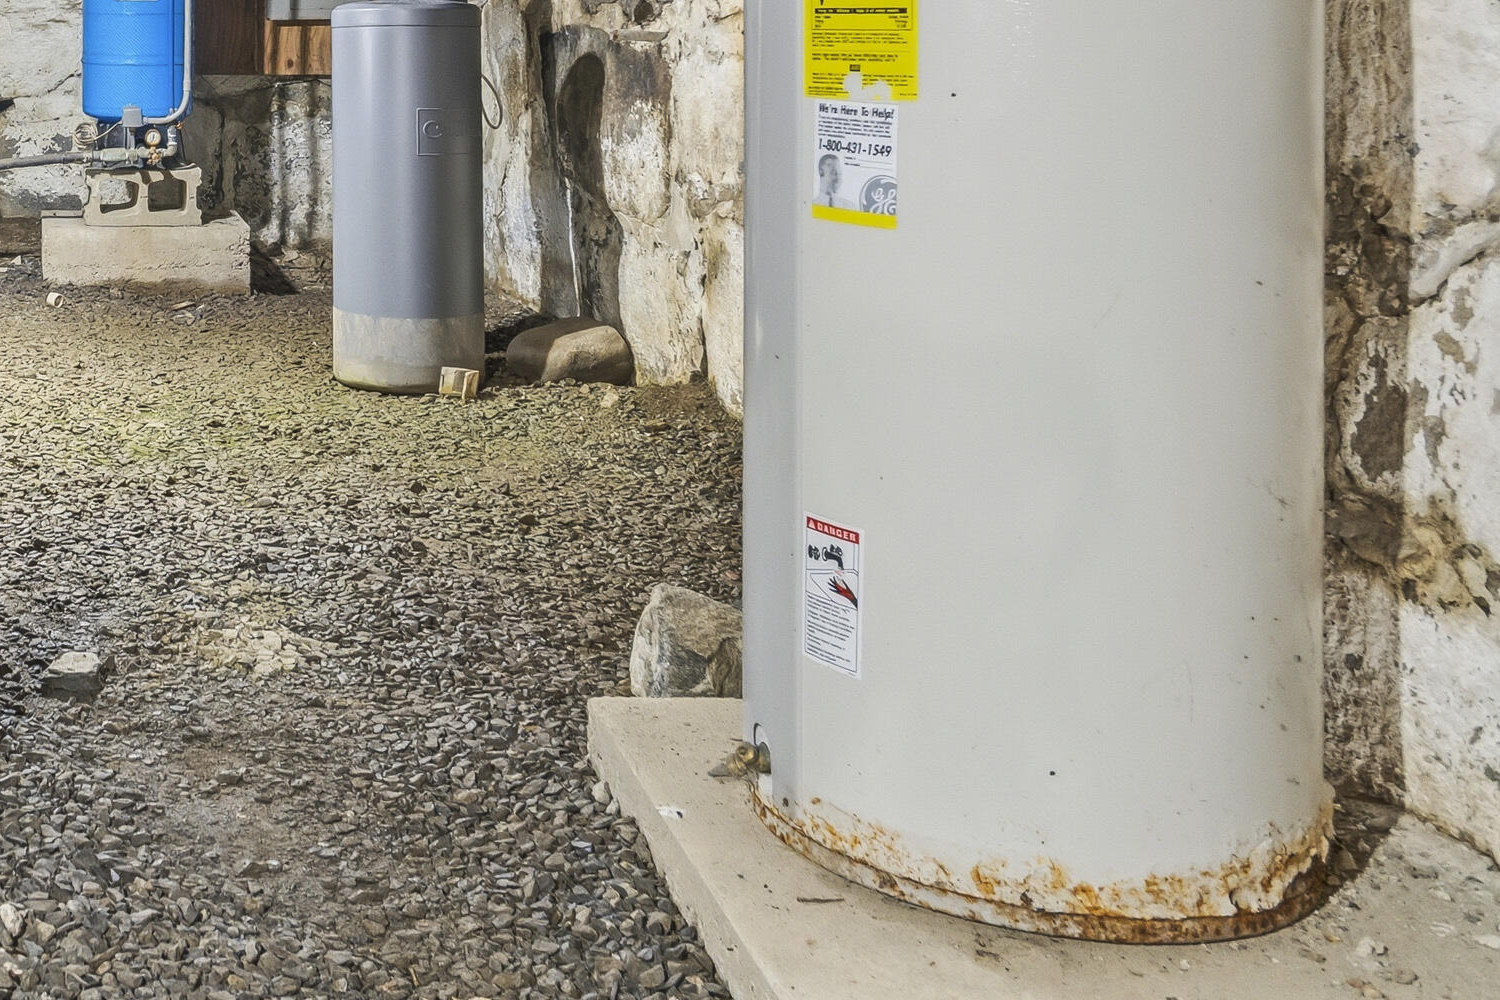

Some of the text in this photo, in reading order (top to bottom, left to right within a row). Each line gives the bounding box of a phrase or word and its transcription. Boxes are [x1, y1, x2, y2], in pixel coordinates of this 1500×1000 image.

[819, 102, 895, 120] We're Here To Help!
[818, 138, 892, 157] 1-800-431-1549
[816, 523, 857, 542] DANGER
